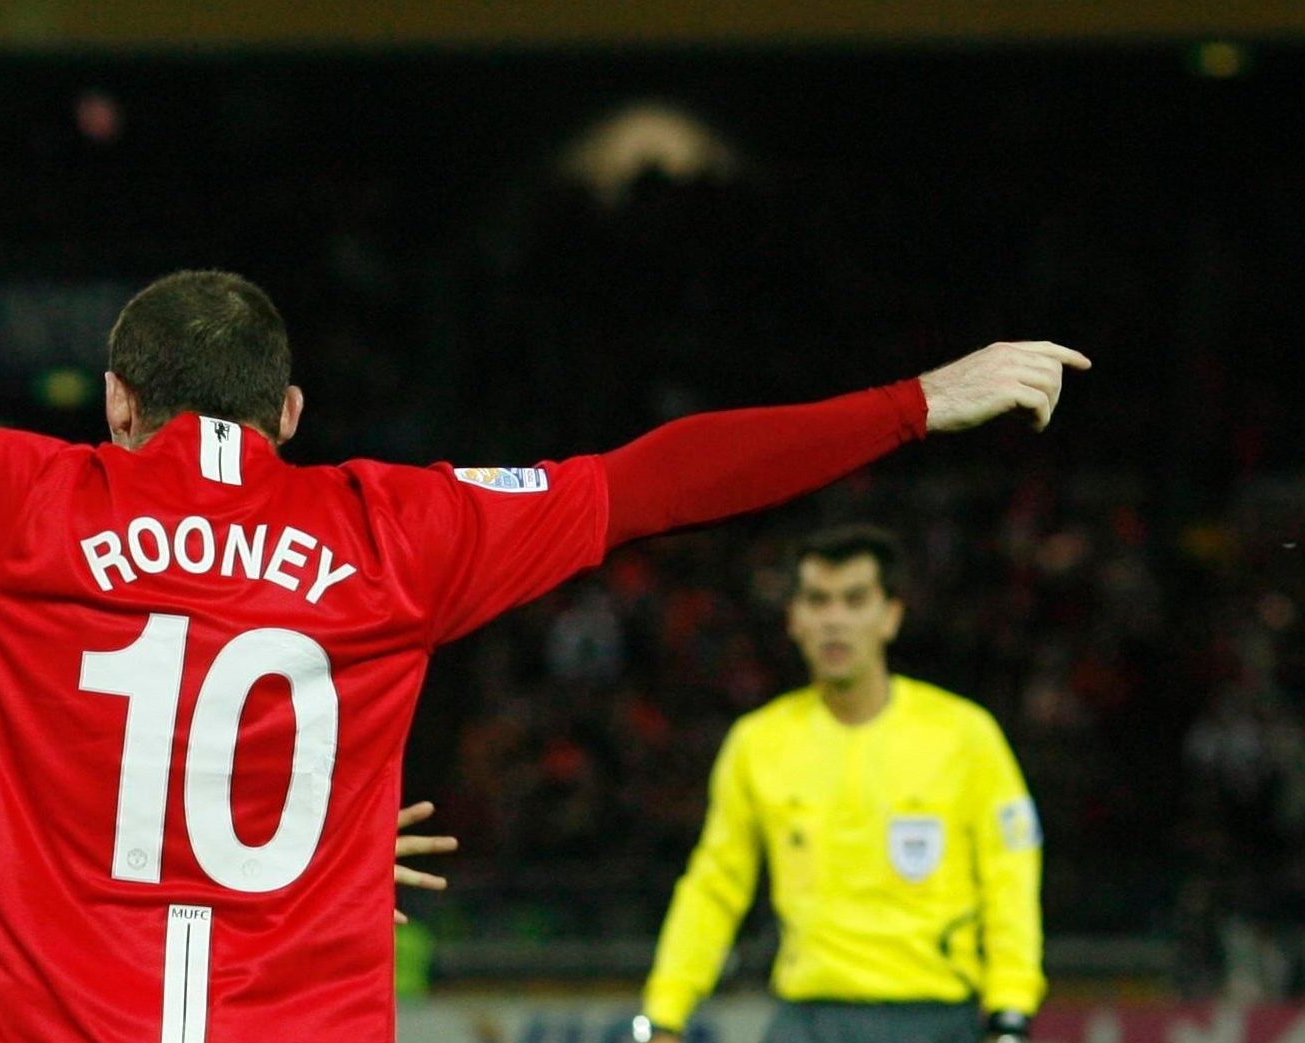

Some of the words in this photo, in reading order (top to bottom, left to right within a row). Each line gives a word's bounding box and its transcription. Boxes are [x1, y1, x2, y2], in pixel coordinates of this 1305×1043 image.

[80, 515, 357, 605] ROONEY
[78, 612, 339, 893] 10
[171, 908, 210, 920] MUFC
